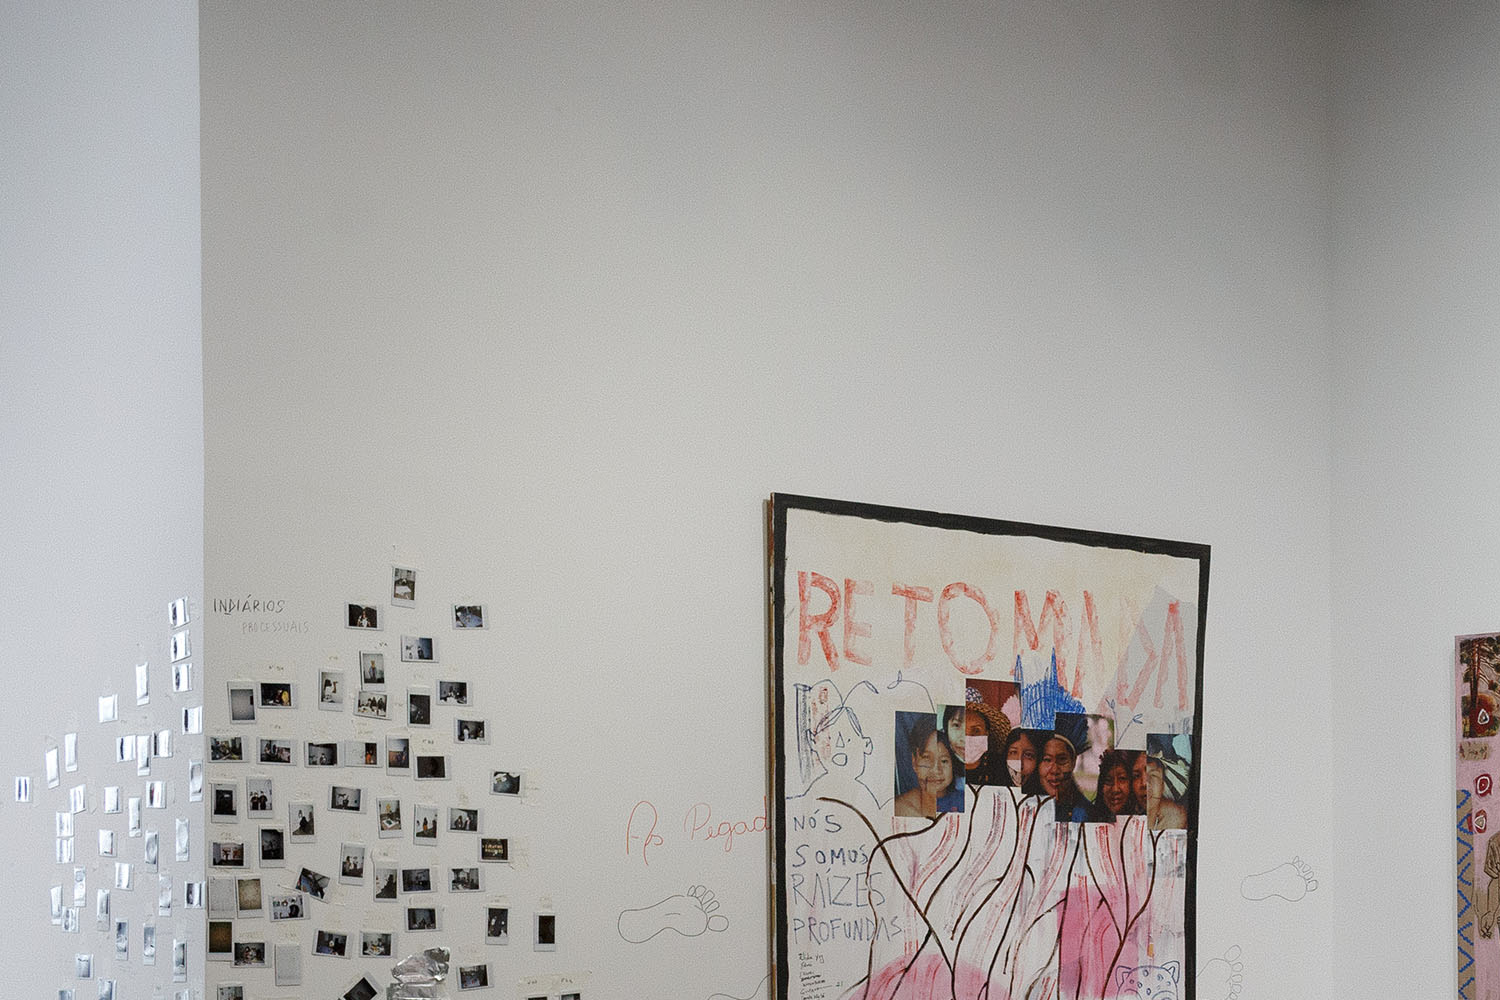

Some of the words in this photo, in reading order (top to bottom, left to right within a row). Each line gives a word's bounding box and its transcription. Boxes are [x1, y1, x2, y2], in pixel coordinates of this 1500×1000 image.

[213, 594, 286, 616] INDIÁRIOS
[793, 809, 842, 834] NÓS
[791, 868, 886, 908] RAÍZES
[793, 916, 902, 945] PROFUNDAS
